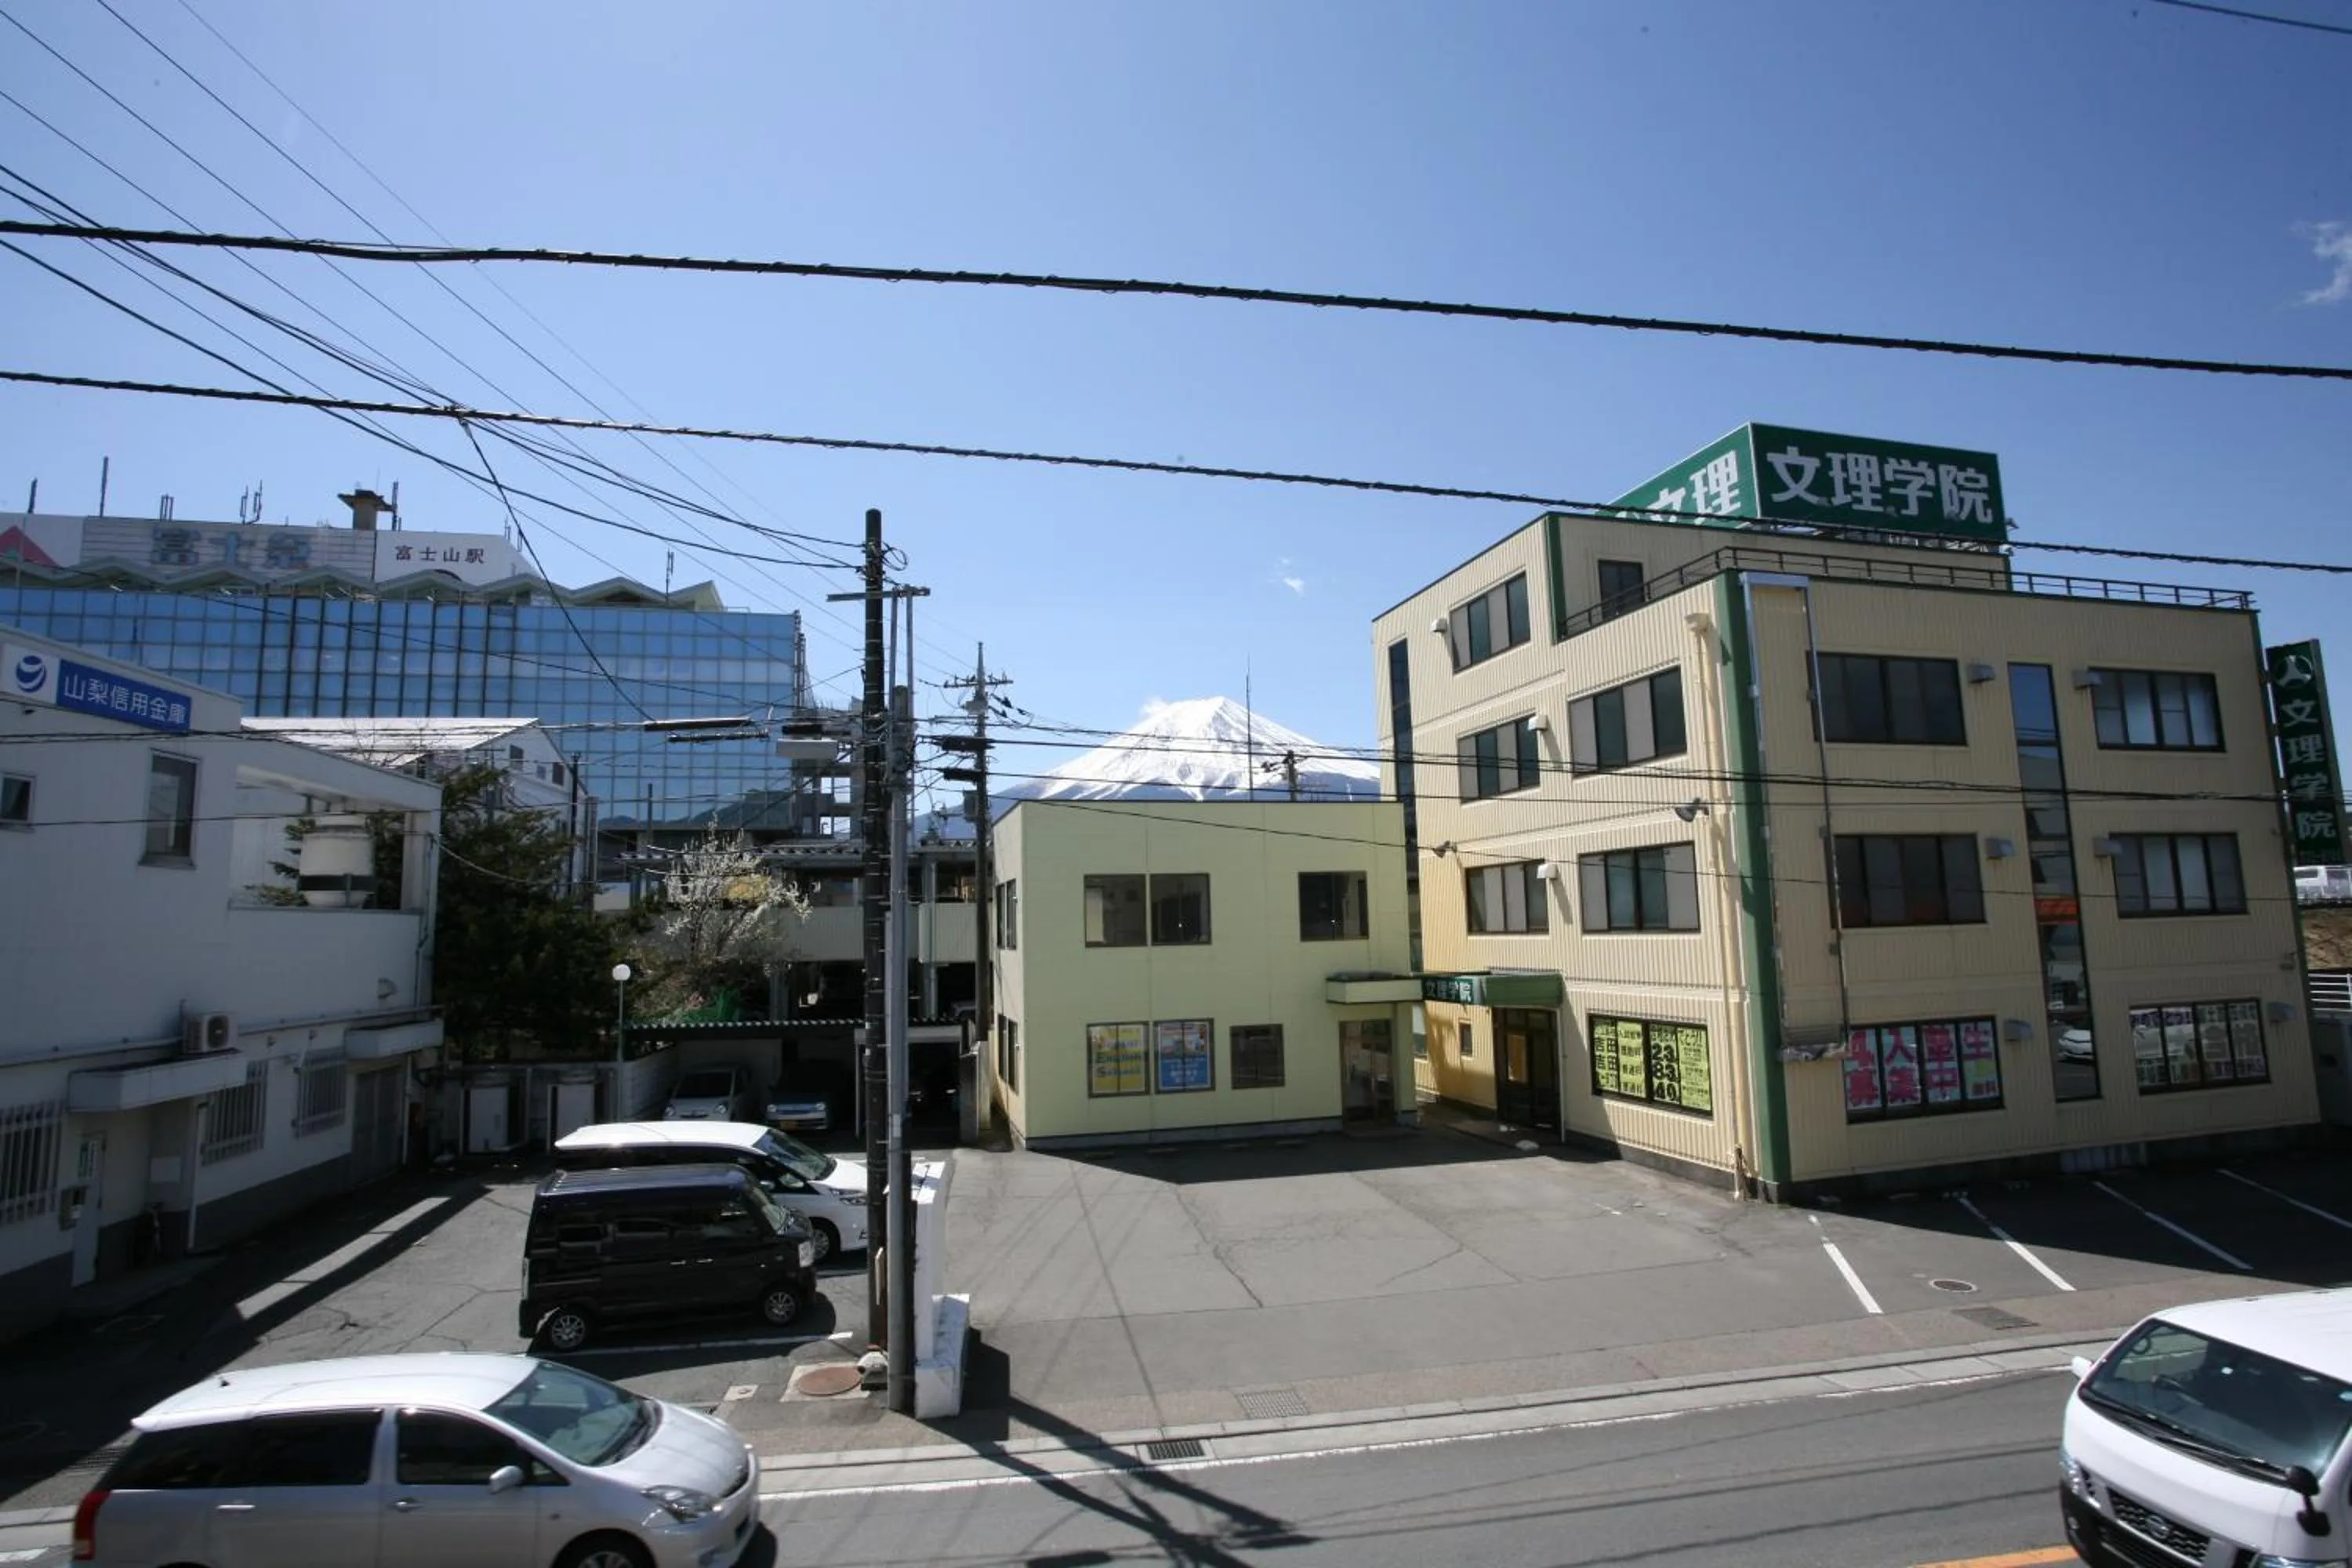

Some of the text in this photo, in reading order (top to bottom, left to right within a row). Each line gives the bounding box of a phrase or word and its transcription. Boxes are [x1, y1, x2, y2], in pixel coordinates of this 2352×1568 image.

[1766, 445, 1994, 524] 文理学院
[394, 544, 486, 565] 富士山駅
[63, 674, 187, 727] 山梨信用金庫
[2281, 698, 2337, 840] 文理学院
